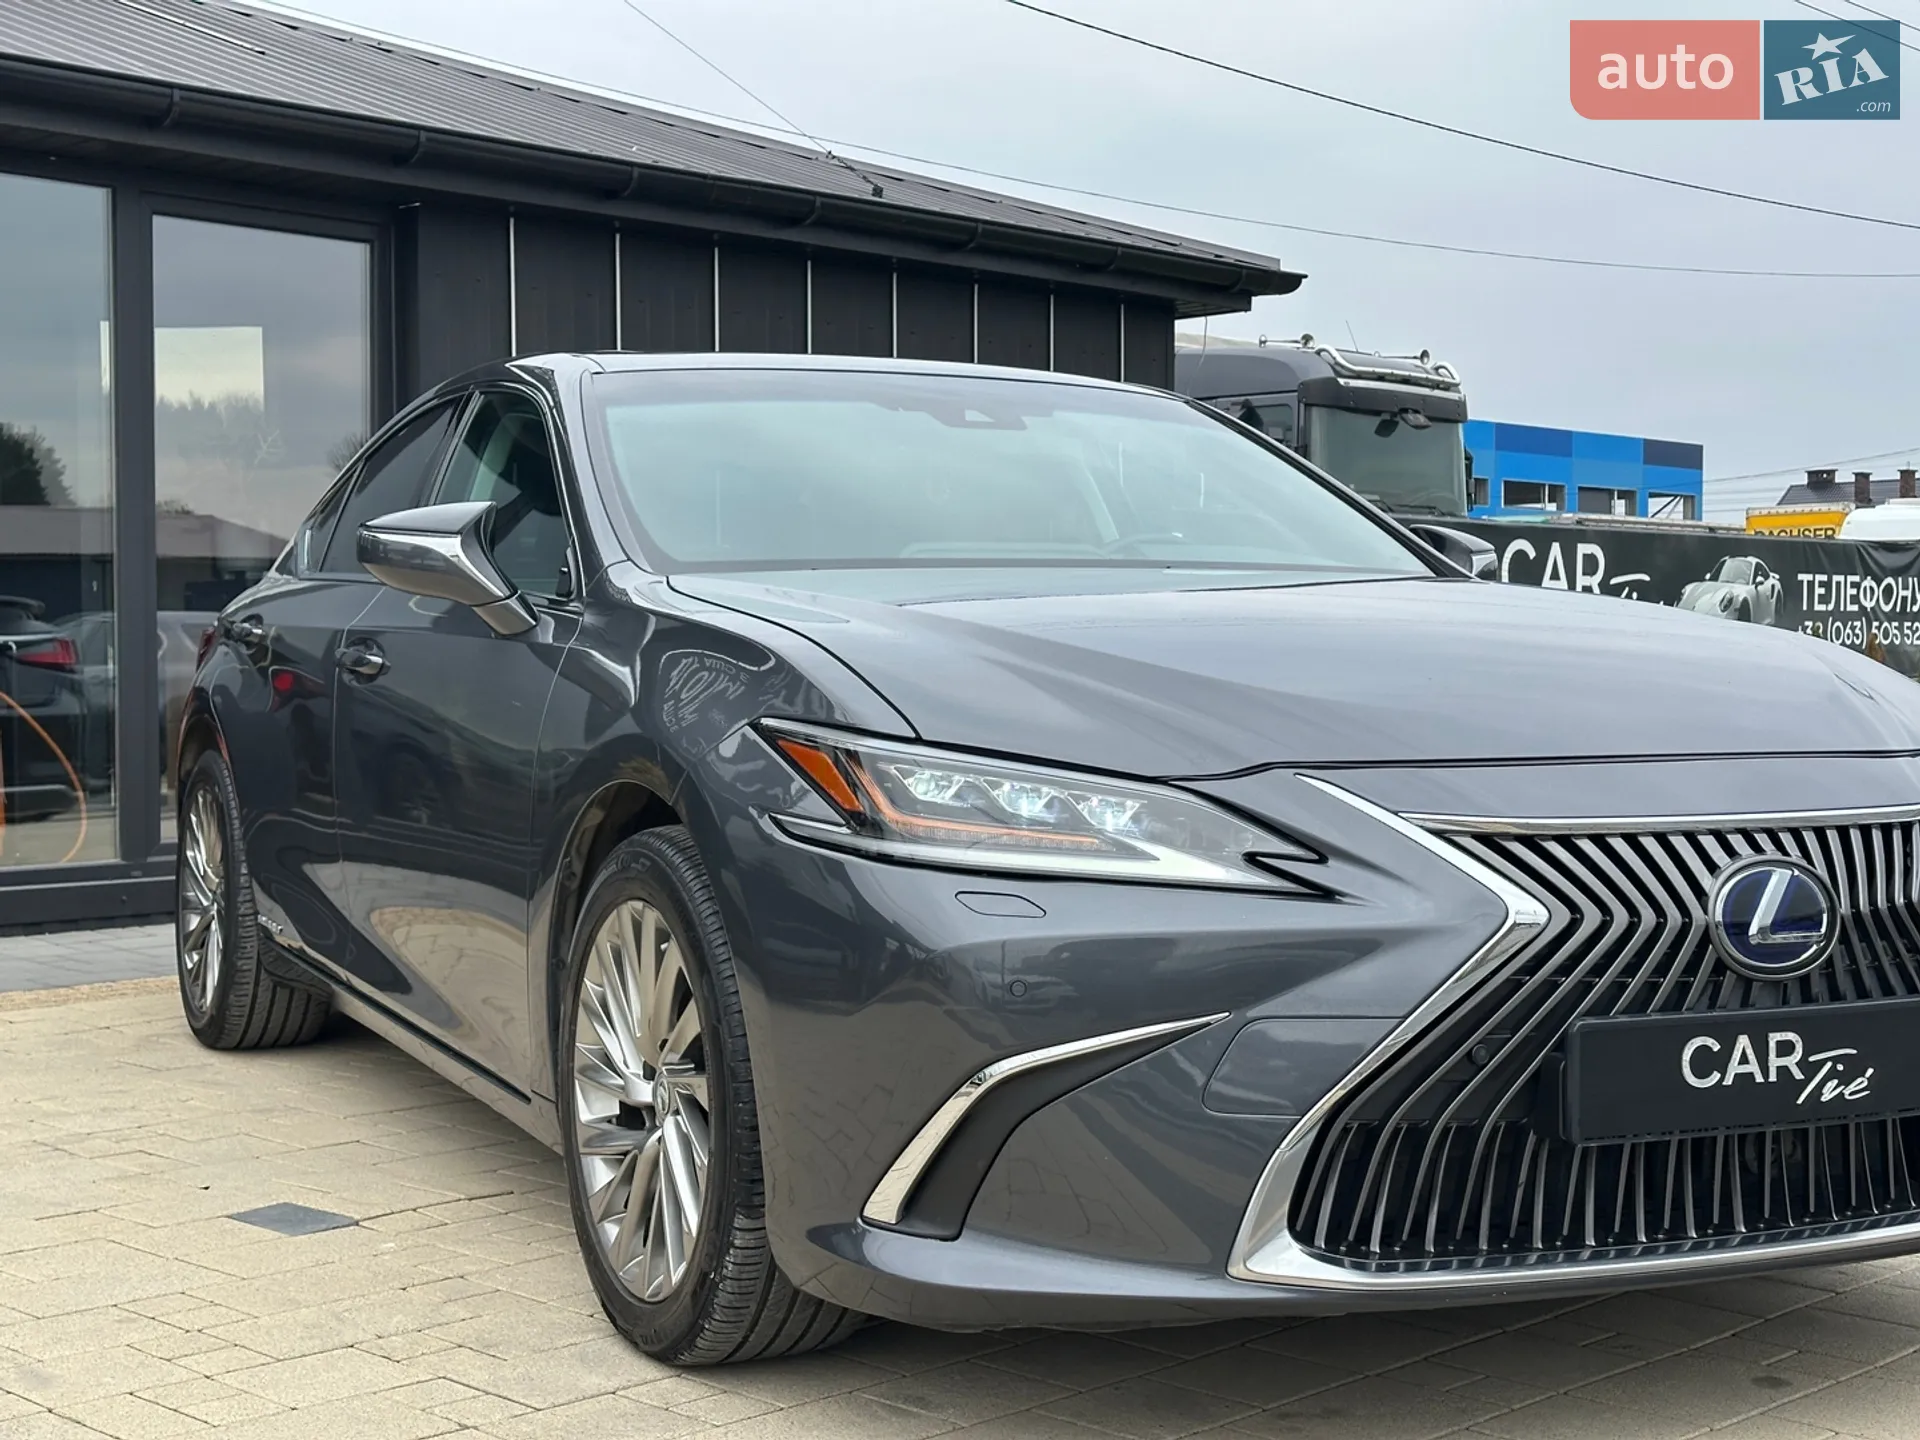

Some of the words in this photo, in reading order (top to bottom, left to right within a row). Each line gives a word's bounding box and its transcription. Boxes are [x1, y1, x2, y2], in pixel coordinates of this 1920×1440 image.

[1501, 538, 1605, 595] CAR
[1827, 616, 1867, 650] (063)
[1871, 621, 1901, 645] 505
[1681, 1031, 1805, 1088] CAR
